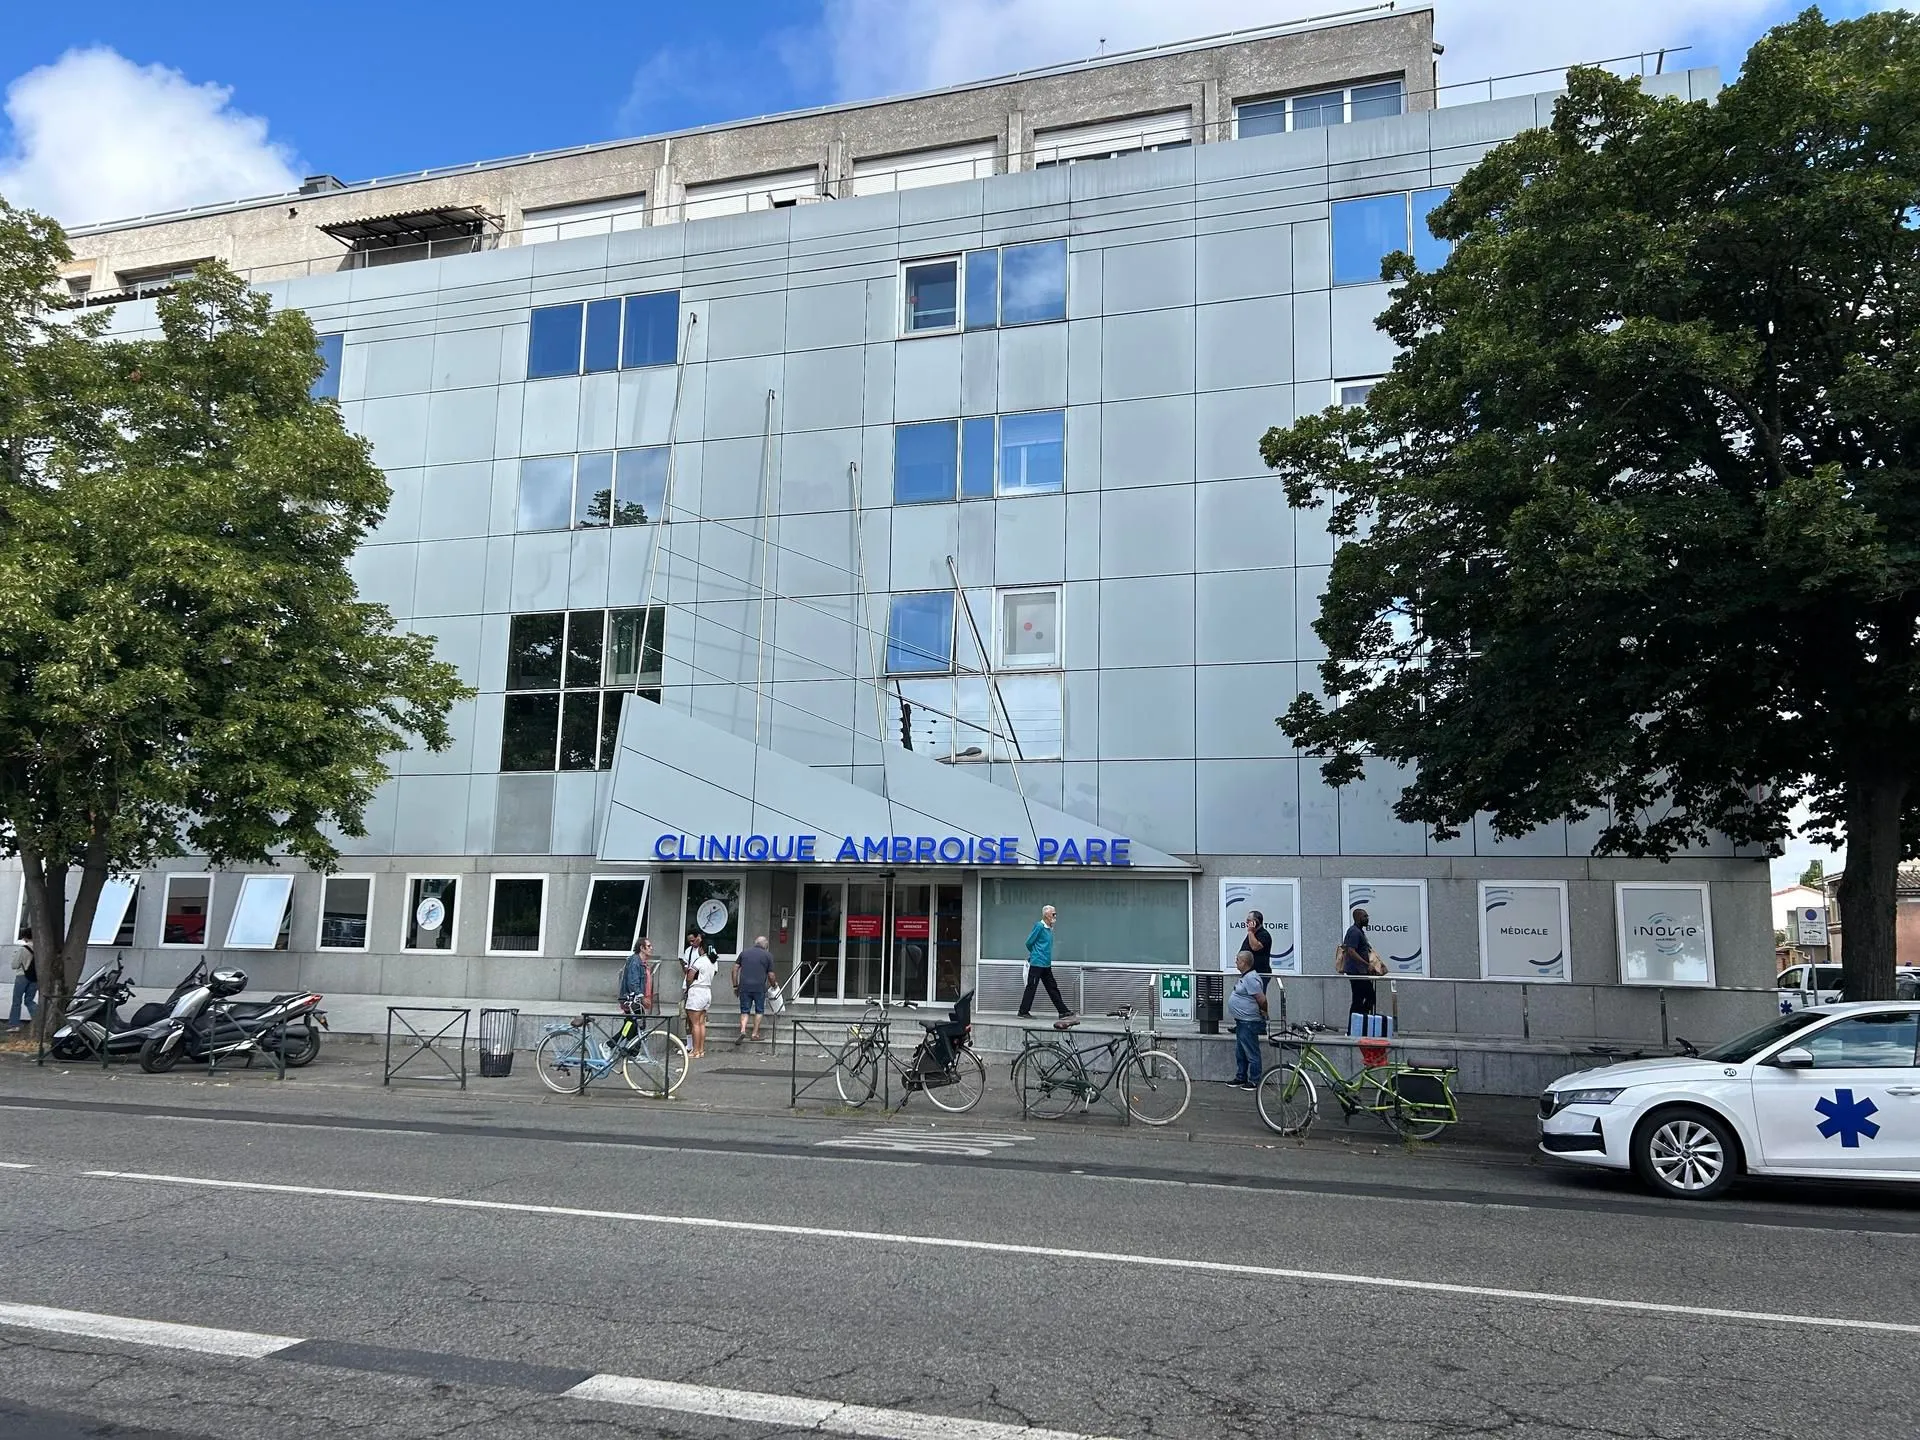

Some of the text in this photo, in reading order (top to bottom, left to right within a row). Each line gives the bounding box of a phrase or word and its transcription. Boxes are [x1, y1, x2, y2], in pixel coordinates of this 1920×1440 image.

[654, 834, 1131, 865] CLINIQUE AMBROISE PARE
[1229, 921, 1289, 930] LABTOIRE
[1366, 924, 1409, 933] BIOLOGIE
[1500, 925, 1549, 936] MÉDICALE
